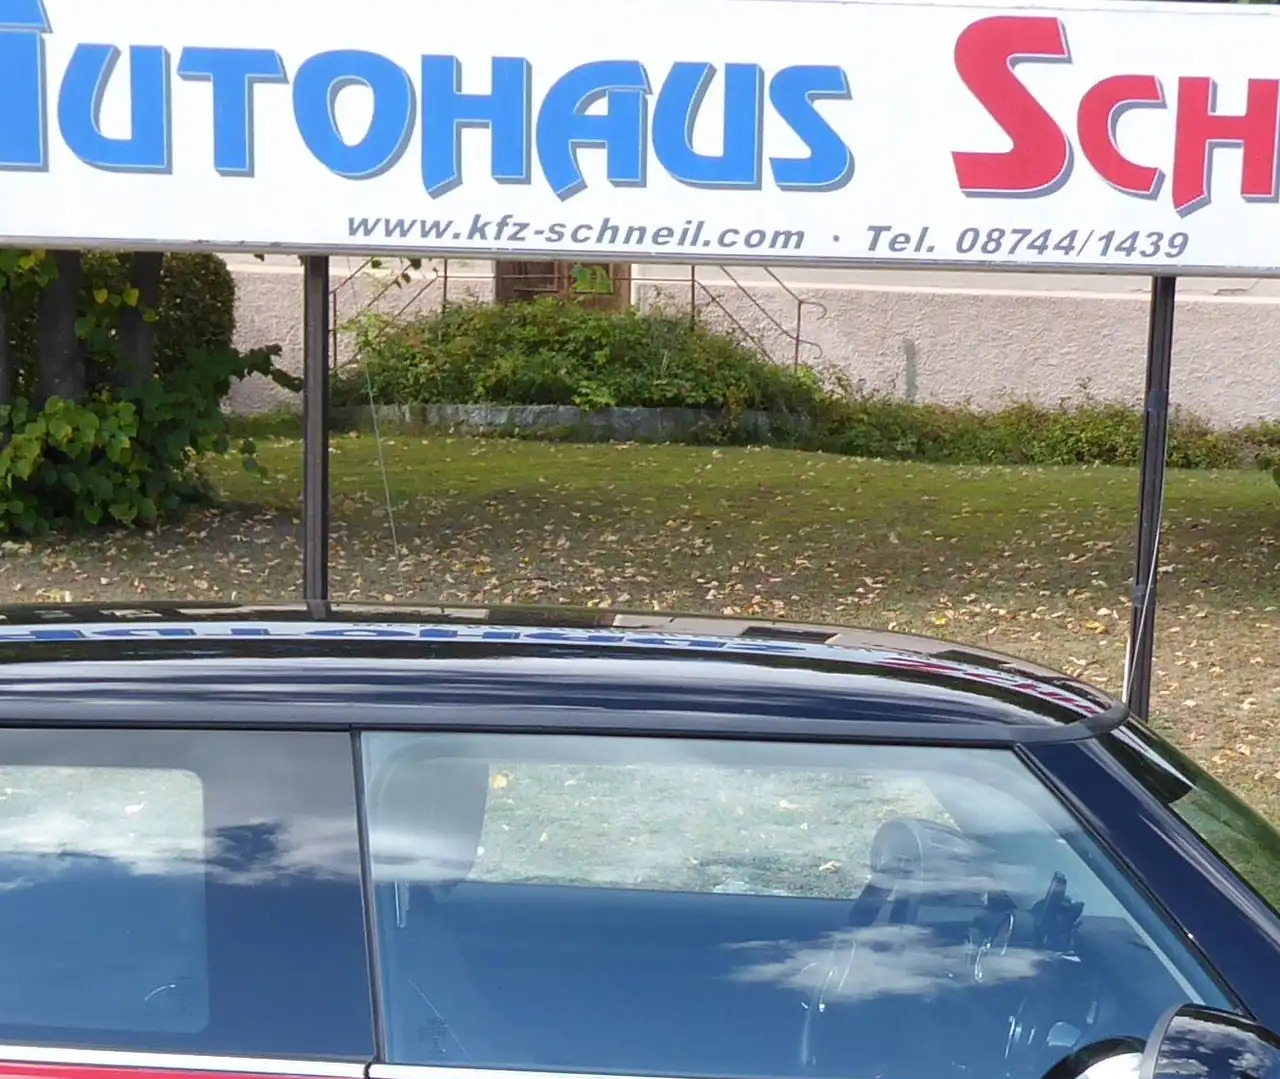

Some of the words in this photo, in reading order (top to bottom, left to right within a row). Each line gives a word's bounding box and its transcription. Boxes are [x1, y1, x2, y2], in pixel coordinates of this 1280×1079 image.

[348, 215, 805, 250] www.kfz-schneil.com
[868, 226, 935, 253] Tel.
[956, 227, 1190, 259] 08744/1439
